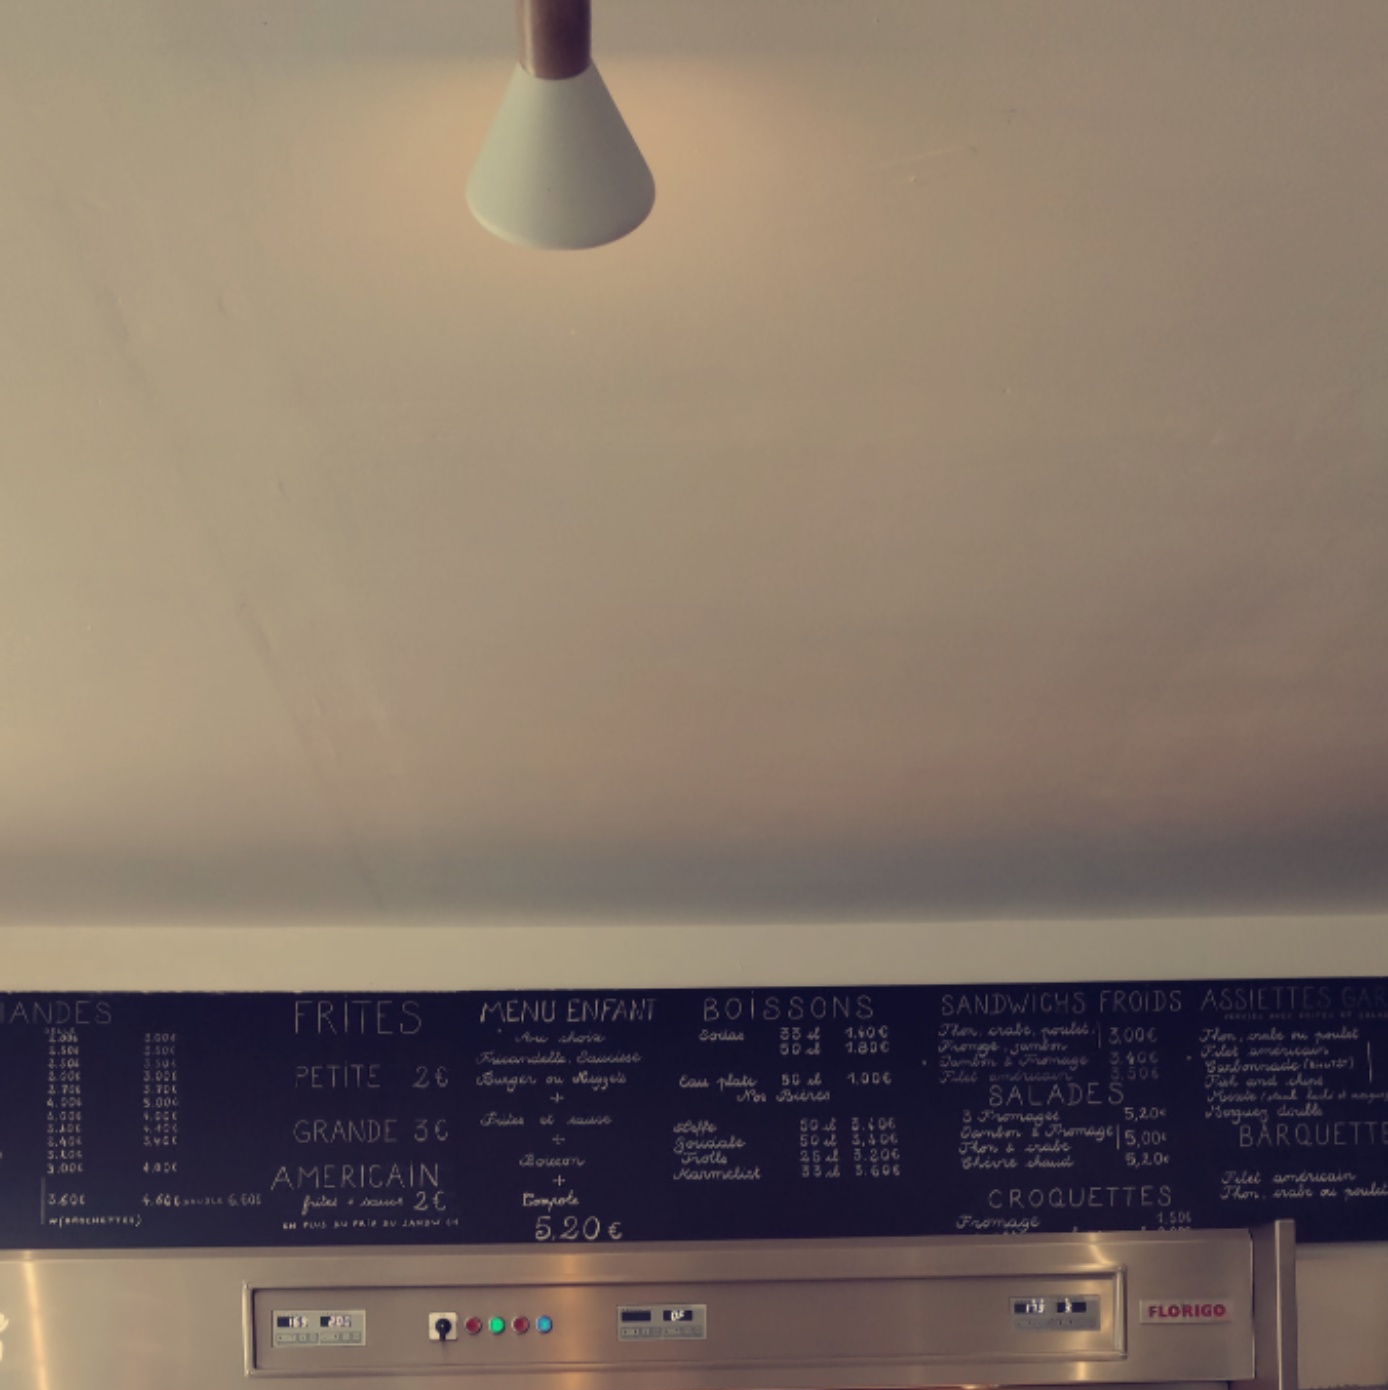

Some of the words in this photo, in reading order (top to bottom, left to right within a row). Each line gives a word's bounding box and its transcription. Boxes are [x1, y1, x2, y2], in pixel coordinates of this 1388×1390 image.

[703, 989, 875, 1022] BOISSONS
[940, 988, 1087, 1017] SANDWICHS
[1098, 984, 1183, 1014] FROIDS
[1200, 982, 1333, 1012] ASSIETTES
[294, 995, 422, 1035] FRITES
[479, 1000, 556, 1024] MENU
[566, 998, 656, 1023] ENFANT
[295, 1061, 380, 1088] PETITE
[988, 1081, 1125, 1107] SALADES
[293, 1118, 398, 1144] GRANDE
[270, 1160, 439, 1191] AMERICAIN
[988, 1184, 1172, 1209] CROQUETTES
[1147, 1303, 1227, 1319] FLORIGO
